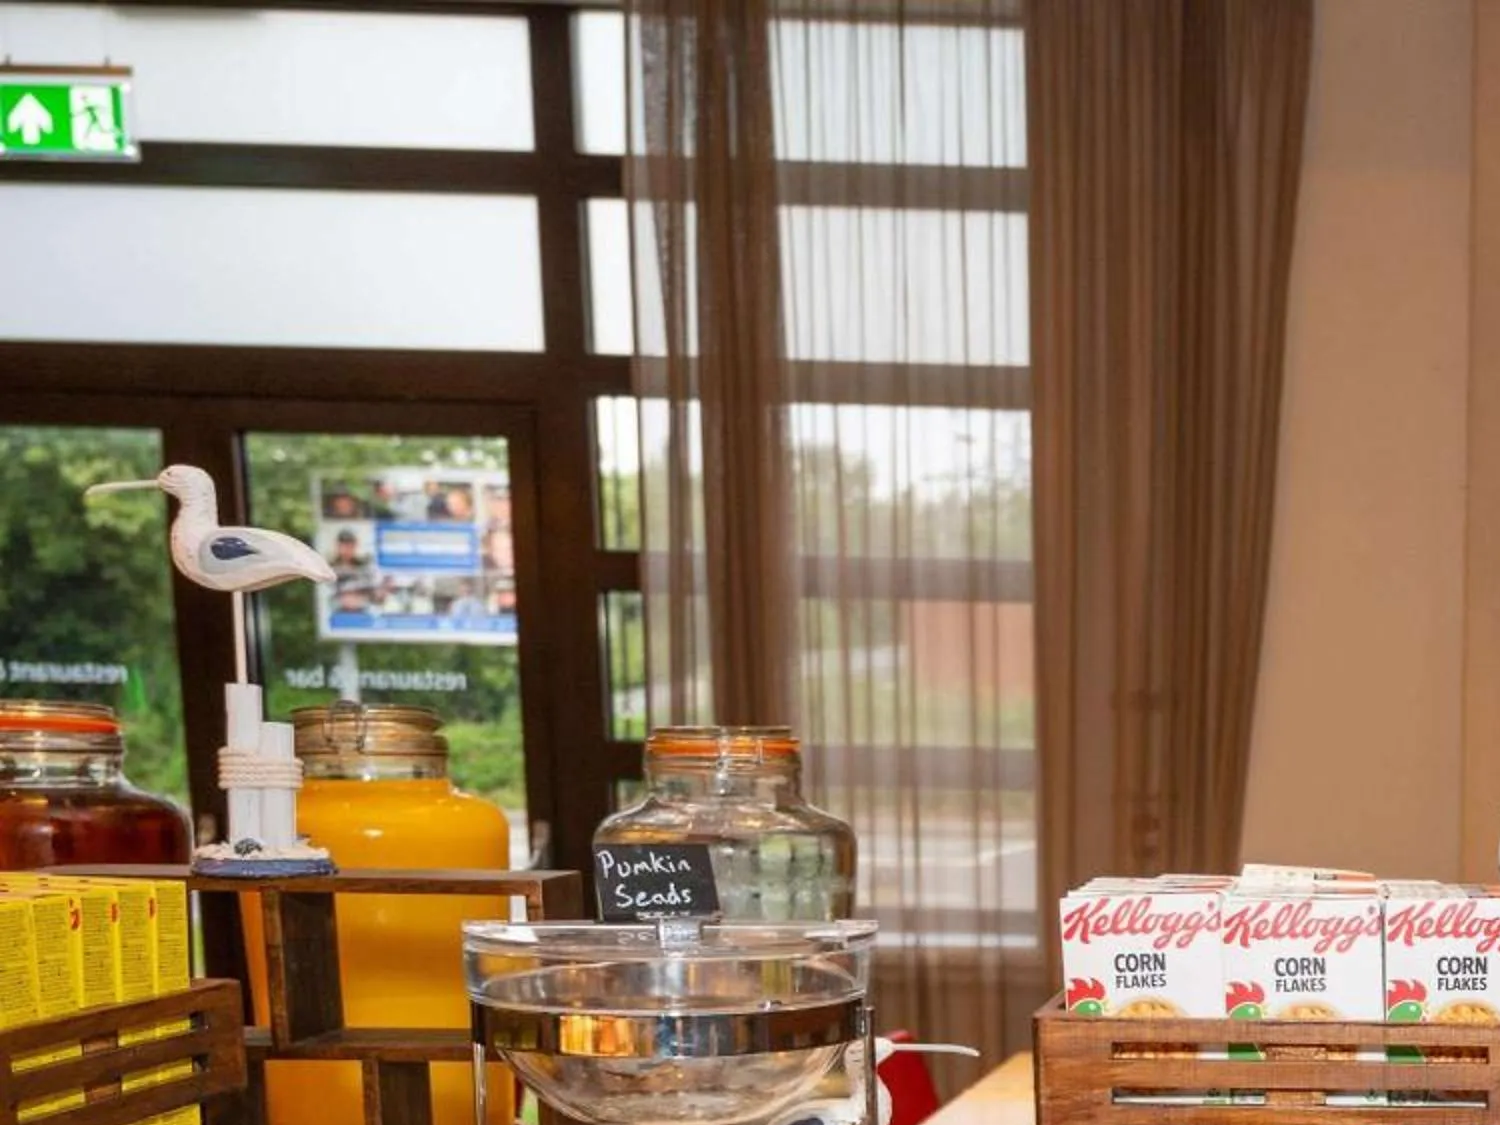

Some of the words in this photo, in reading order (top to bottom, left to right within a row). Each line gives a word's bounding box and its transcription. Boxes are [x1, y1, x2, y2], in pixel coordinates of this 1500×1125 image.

[596, 850, 691, 879] Pumkin
[1063, 896, 1222, 950] Kellogg's
[1223, 899, 1382, 953] Kellogg's
[1114, 953, 1167, 973] CORN
[1274, 956, 1327, 977] CORN
[1437, 956, 1488, 975] CORN
[1115, 973, 1167, 989] FLAKES
[1275, 976, 1327, 992] FLAKES
[1437, 977, 1488, 991] FLAKES
